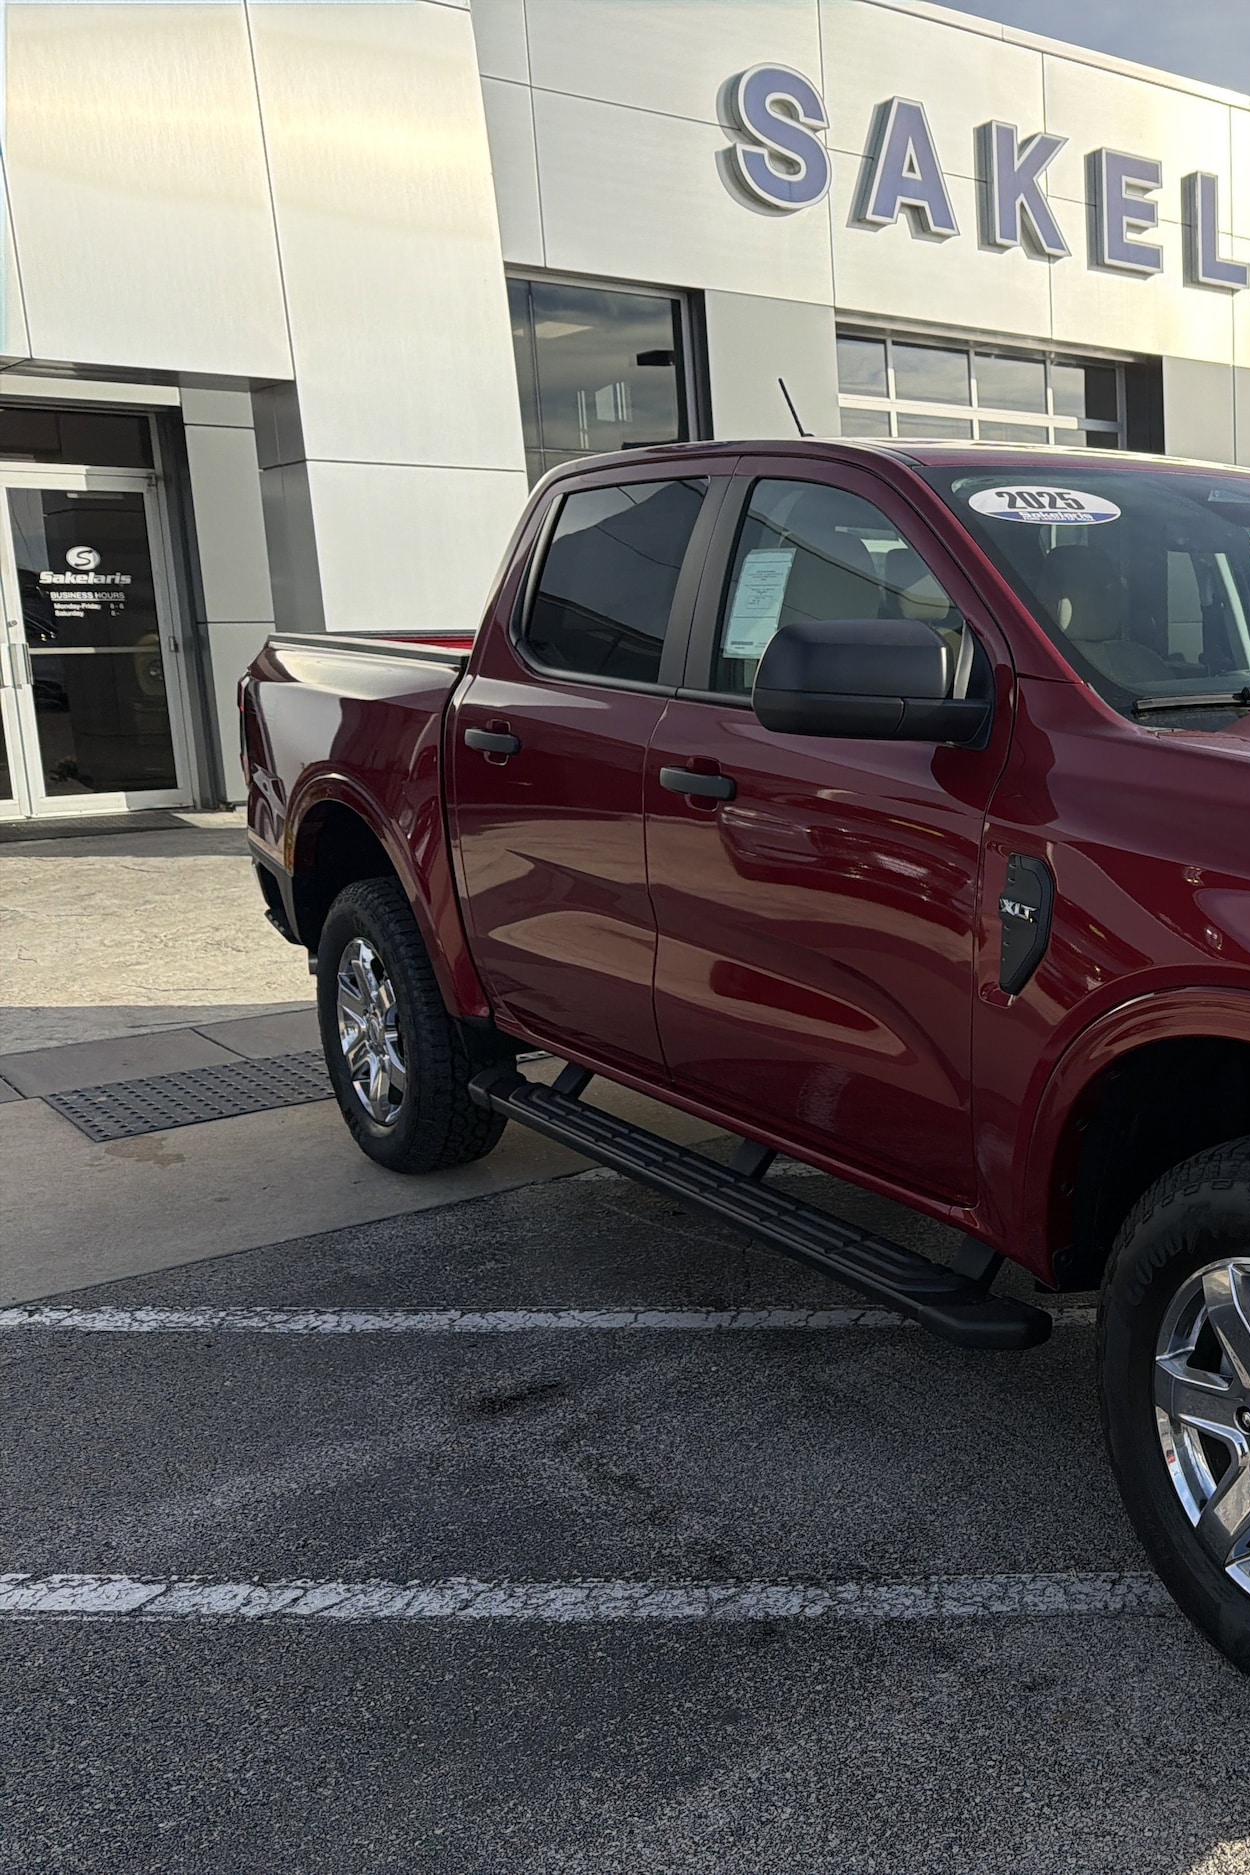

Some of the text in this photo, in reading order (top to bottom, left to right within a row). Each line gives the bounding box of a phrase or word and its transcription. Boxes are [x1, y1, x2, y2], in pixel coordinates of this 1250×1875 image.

[995, 491, 1085, 510] 2025
[39, 571, 131, 584] Sakelaris
[50, 591, 125, 600] BUSINESS HOURS
[1000, 898, 1037, 920] XLT
